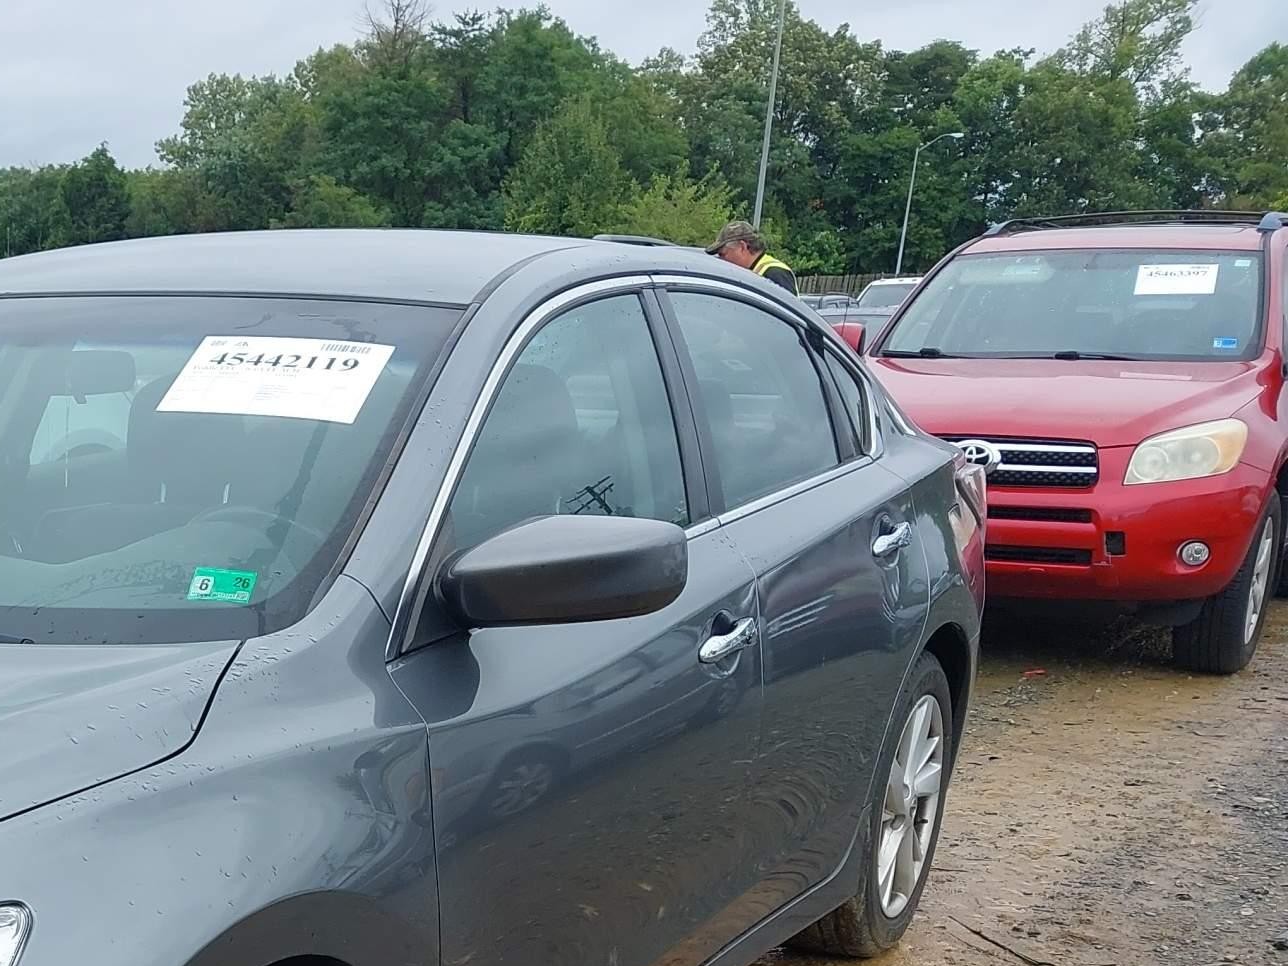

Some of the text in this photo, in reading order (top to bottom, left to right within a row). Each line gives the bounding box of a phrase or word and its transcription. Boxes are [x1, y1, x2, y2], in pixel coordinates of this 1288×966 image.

[208, 351, 360, 371] 45442119
[199, 578, 211, 591] 6
[234, 577, 251, 589] 26
